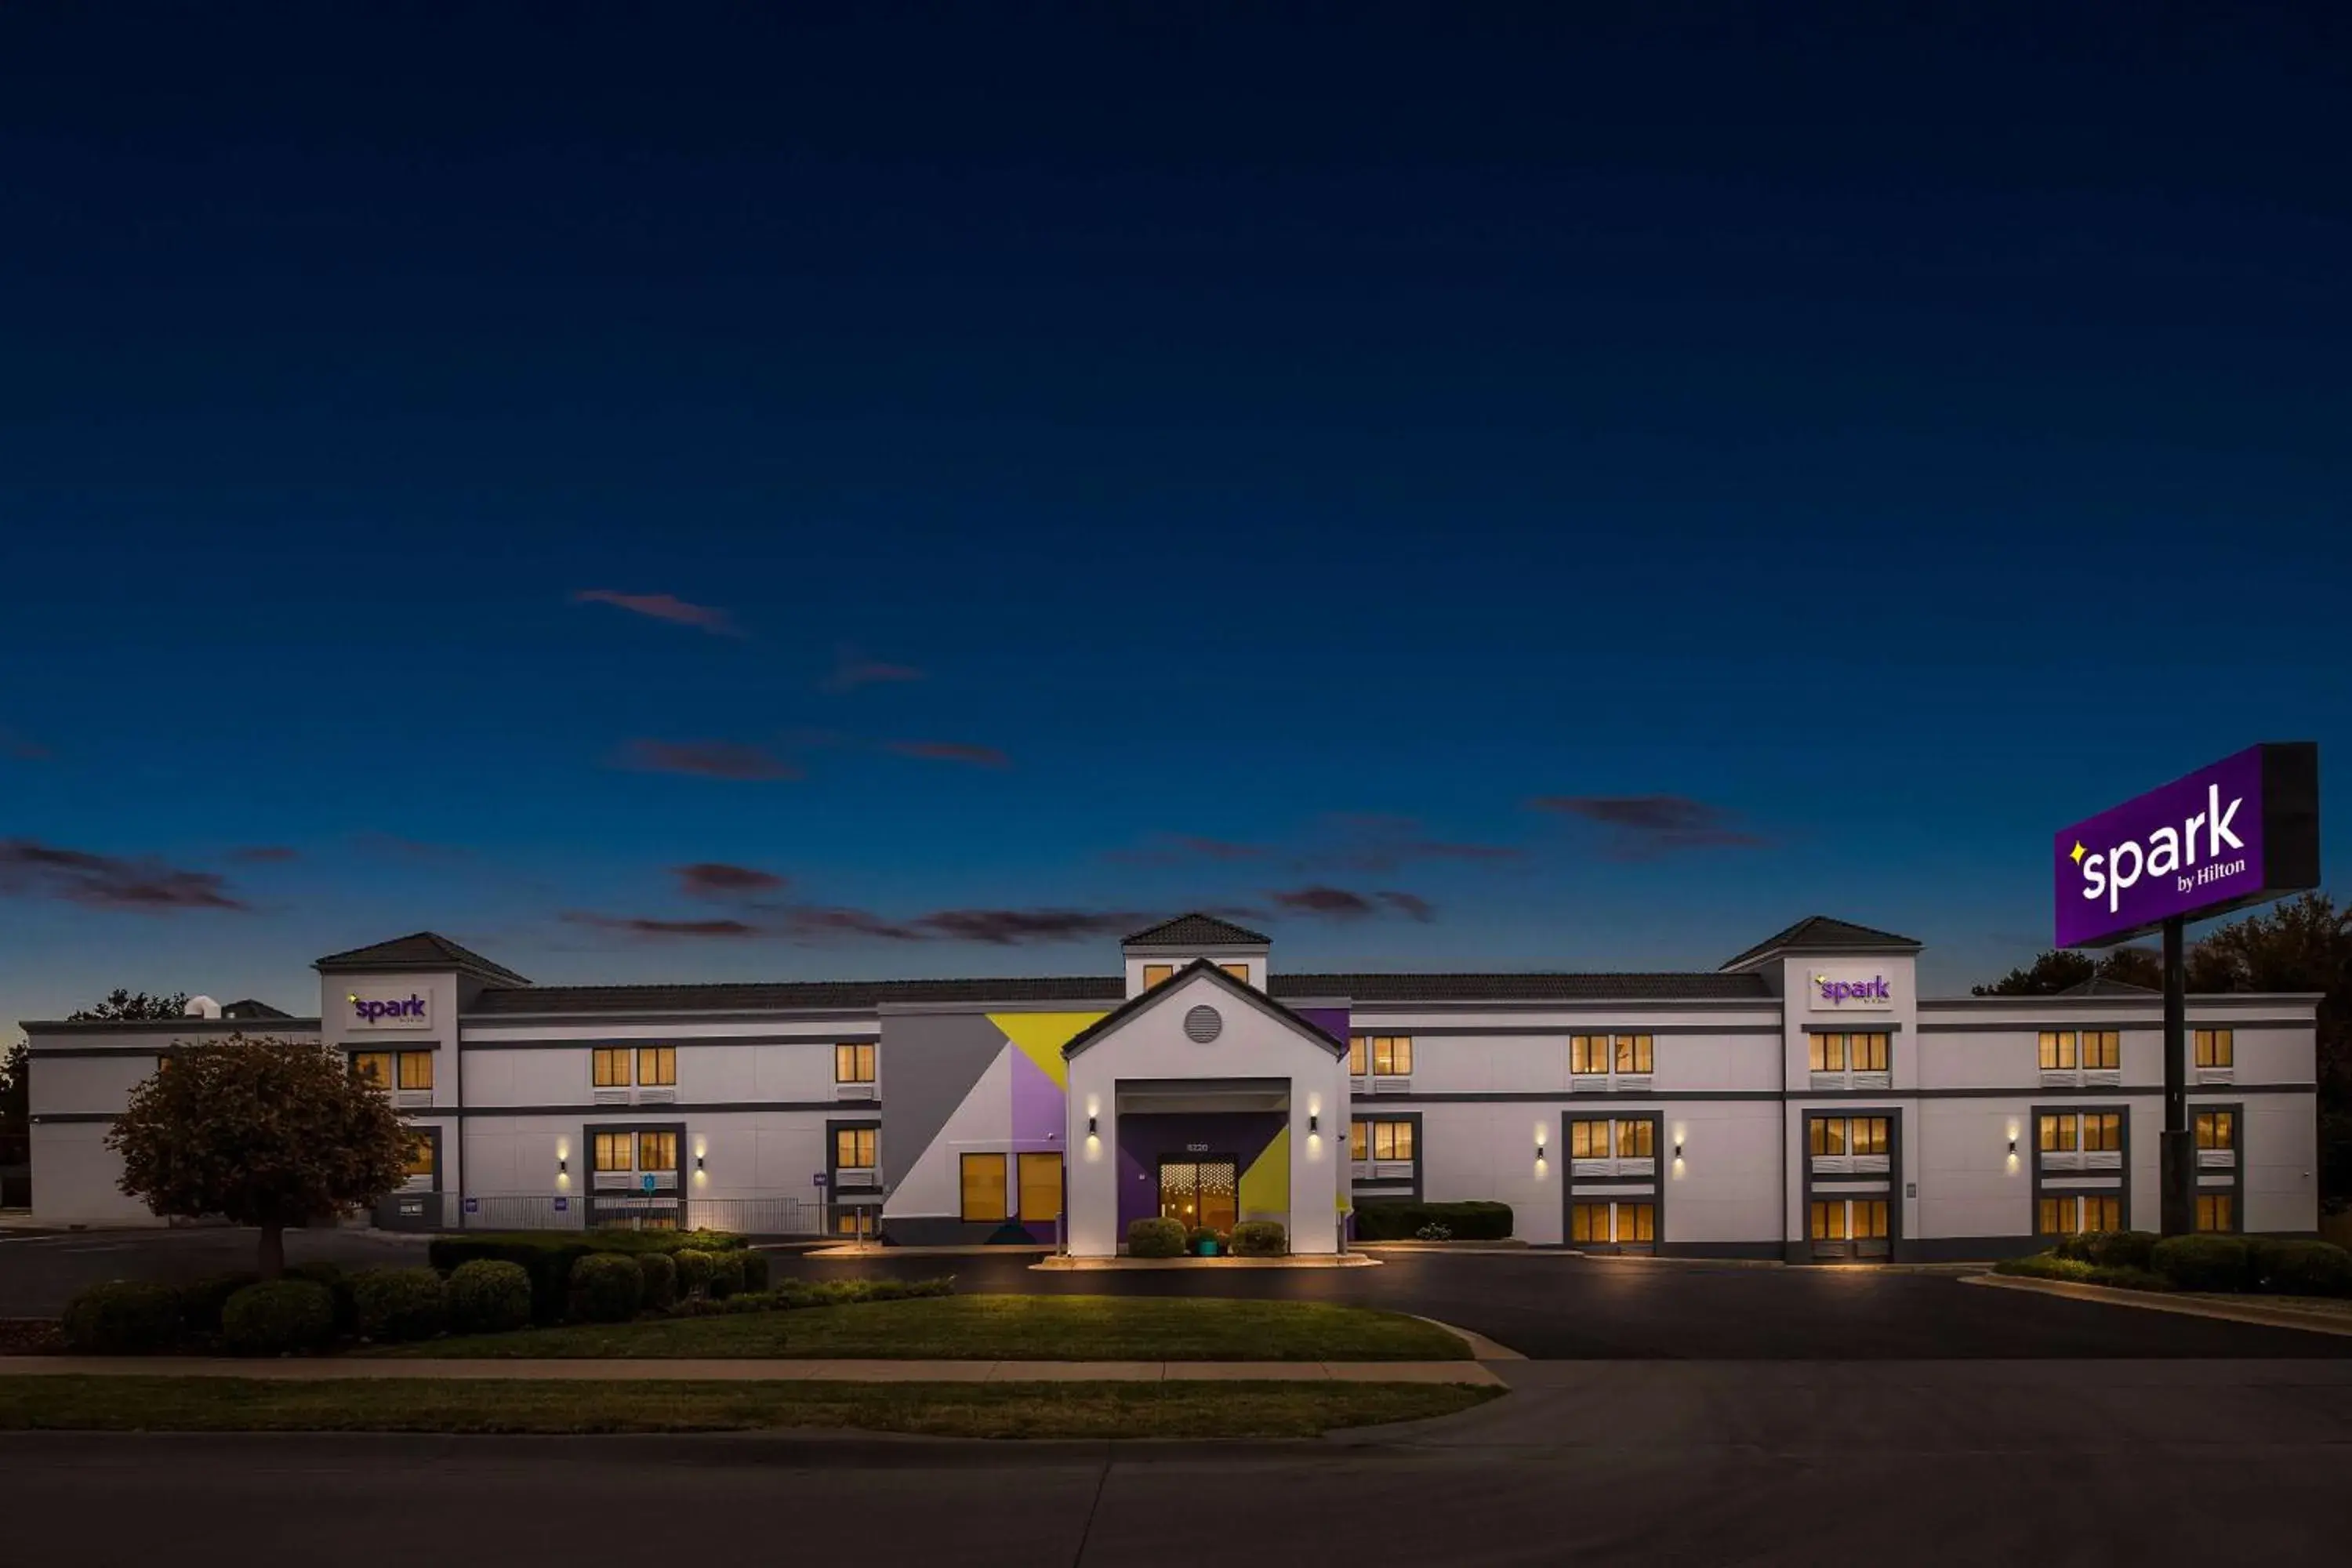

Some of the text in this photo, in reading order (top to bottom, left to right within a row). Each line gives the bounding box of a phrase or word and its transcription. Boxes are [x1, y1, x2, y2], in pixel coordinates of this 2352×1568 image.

[2083, 783, 2244, 913] spark
[2177, 858, 2245, 893] by Hilton
[1821, 975, 1890, 1004] spark
[355, 993, 426, 1024] spark
